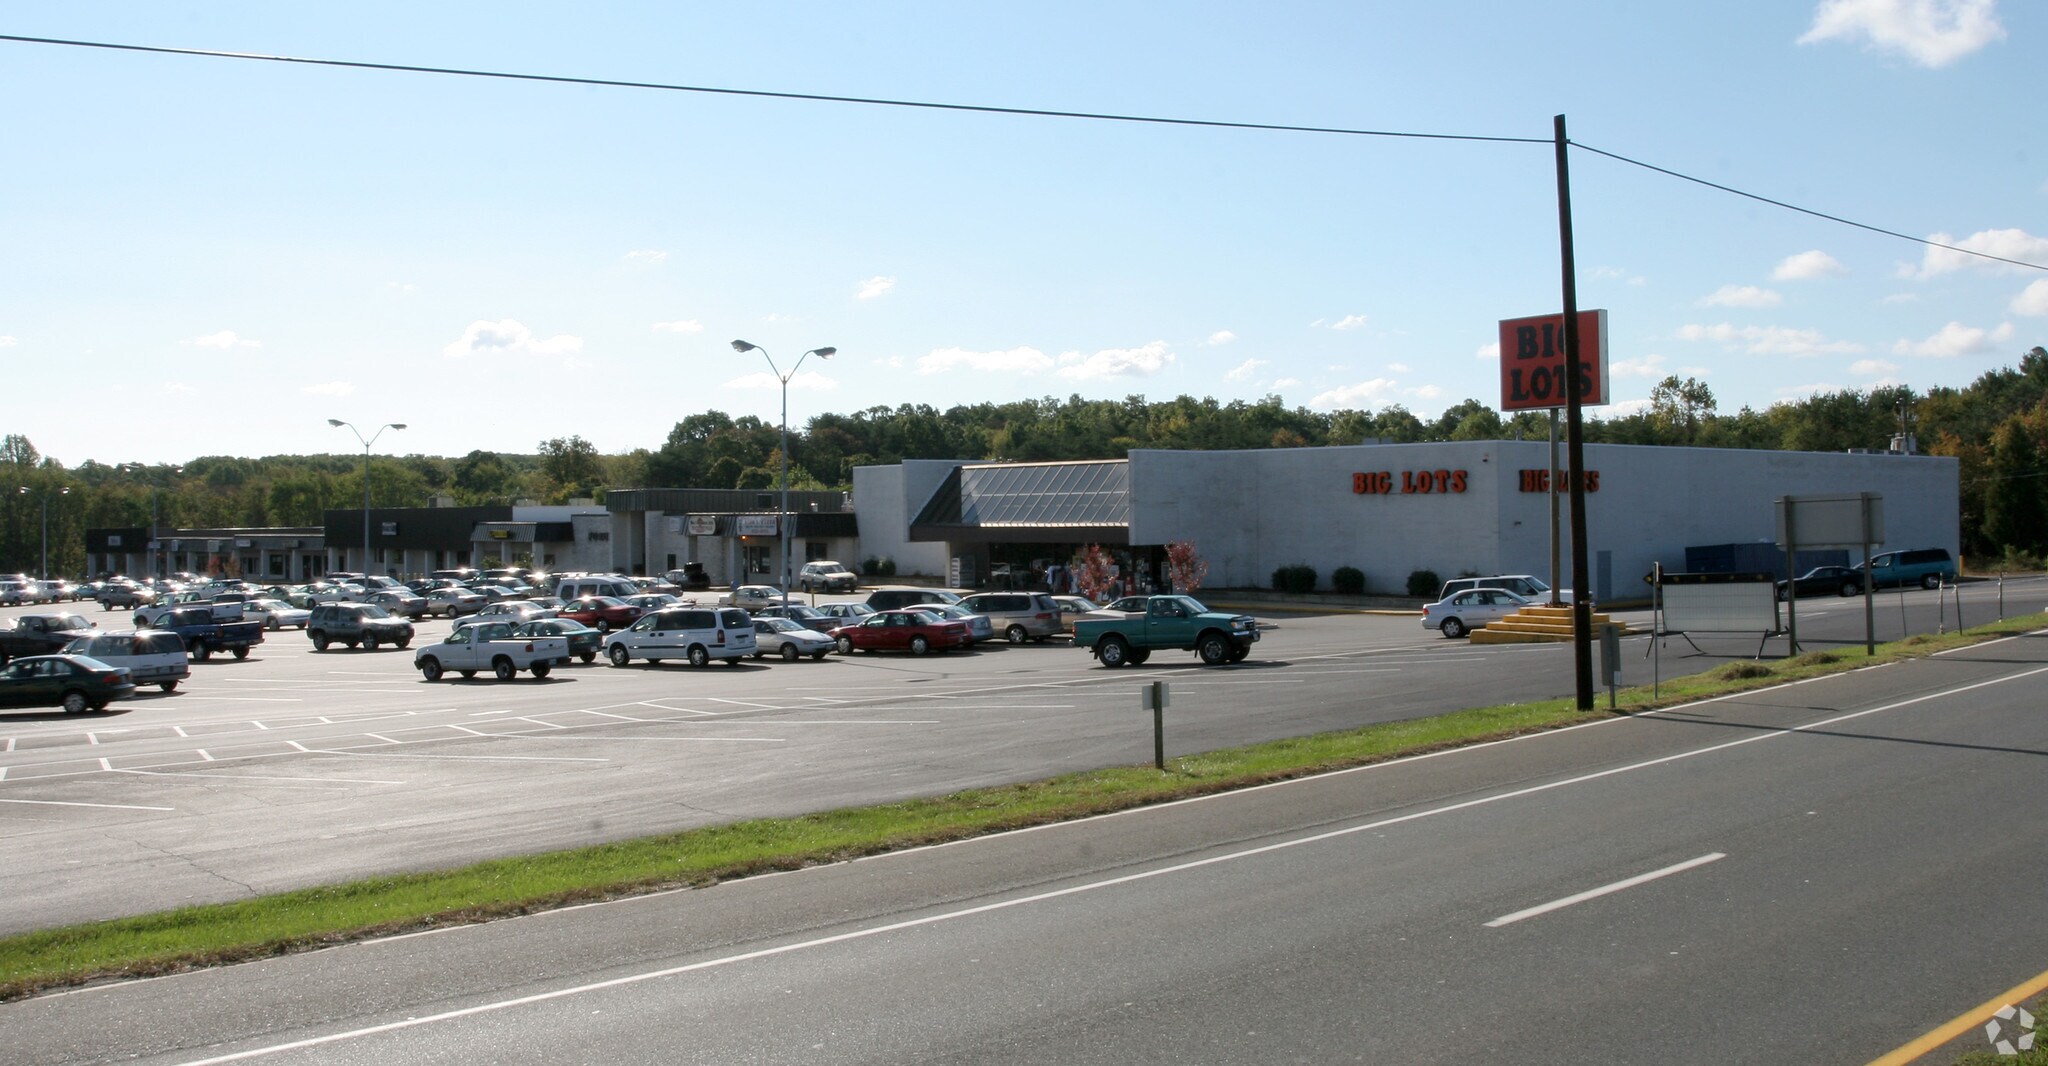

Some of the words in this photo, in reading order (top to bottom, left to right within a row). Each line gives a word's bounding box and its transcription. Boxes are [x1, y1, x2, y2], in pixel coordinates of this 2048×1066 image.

[1353, 471, 1392, 494] BIG
[1401, 469, 1469, 494] LOTS
[1519, 470, 1552, 494] BIG
